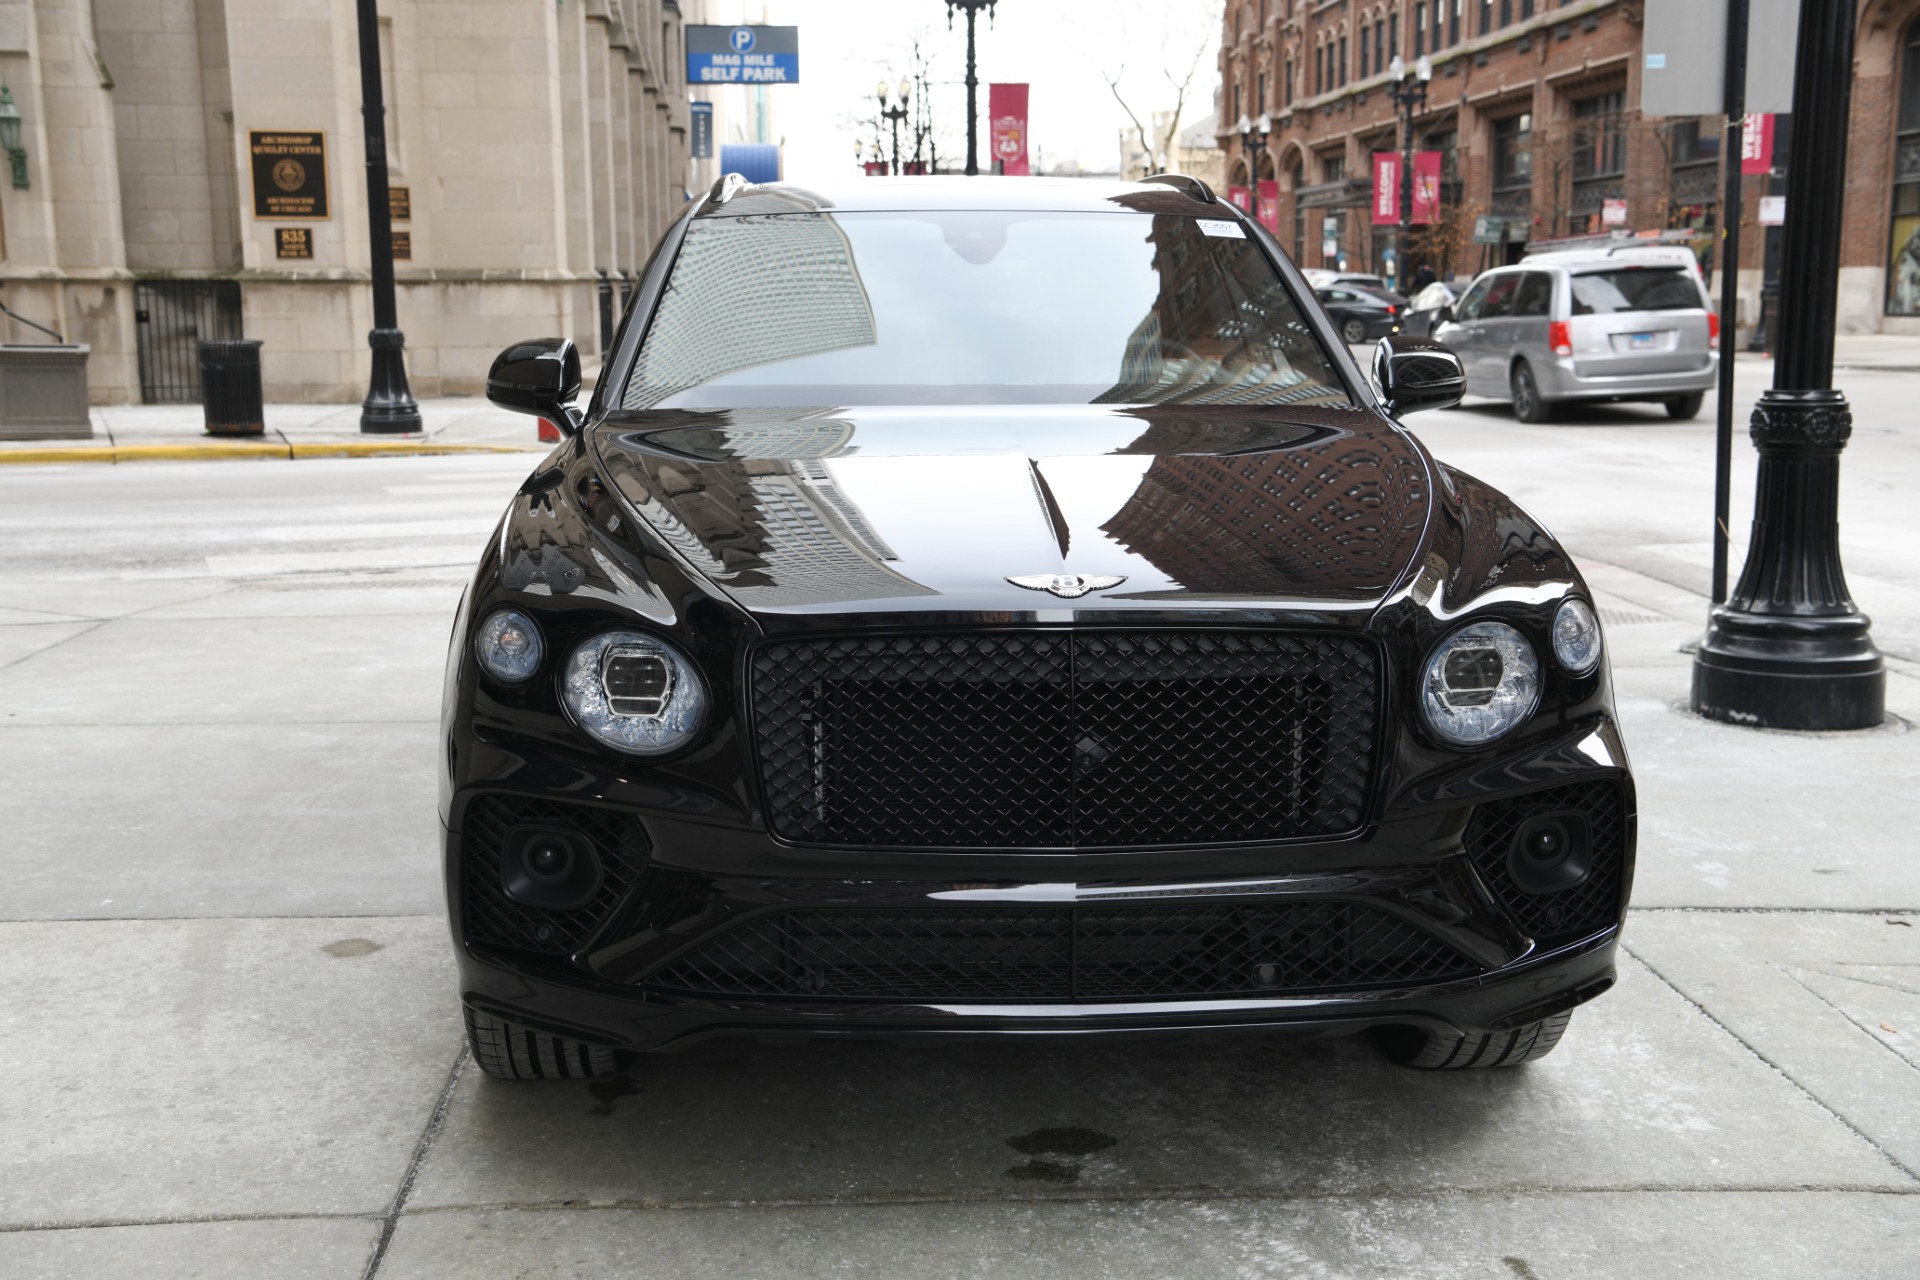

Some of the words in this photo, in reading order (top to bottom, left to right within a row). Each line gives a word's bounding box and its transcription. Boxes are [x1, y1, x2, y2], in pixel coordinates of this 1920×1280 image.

[736, 30, 751, 50] P
[712, 54, 741, 66] MAG
[743, 54, 775, 66] MILE
[701, 67, 740, 81] SELF
[743, 67, 786, 81] PARK
[260, 136, 313, 144] ARCHBISHOP
[253, 145, 288, 155] QUIGLEY
[289, 145, 322, 155] CENTER
[1379, 161, 1389, 216] WELCOME
[270, 205, 280, 213] OF
[280, 205, 313, 213] CHICAGO
[281, 230, 306, 243] 835
